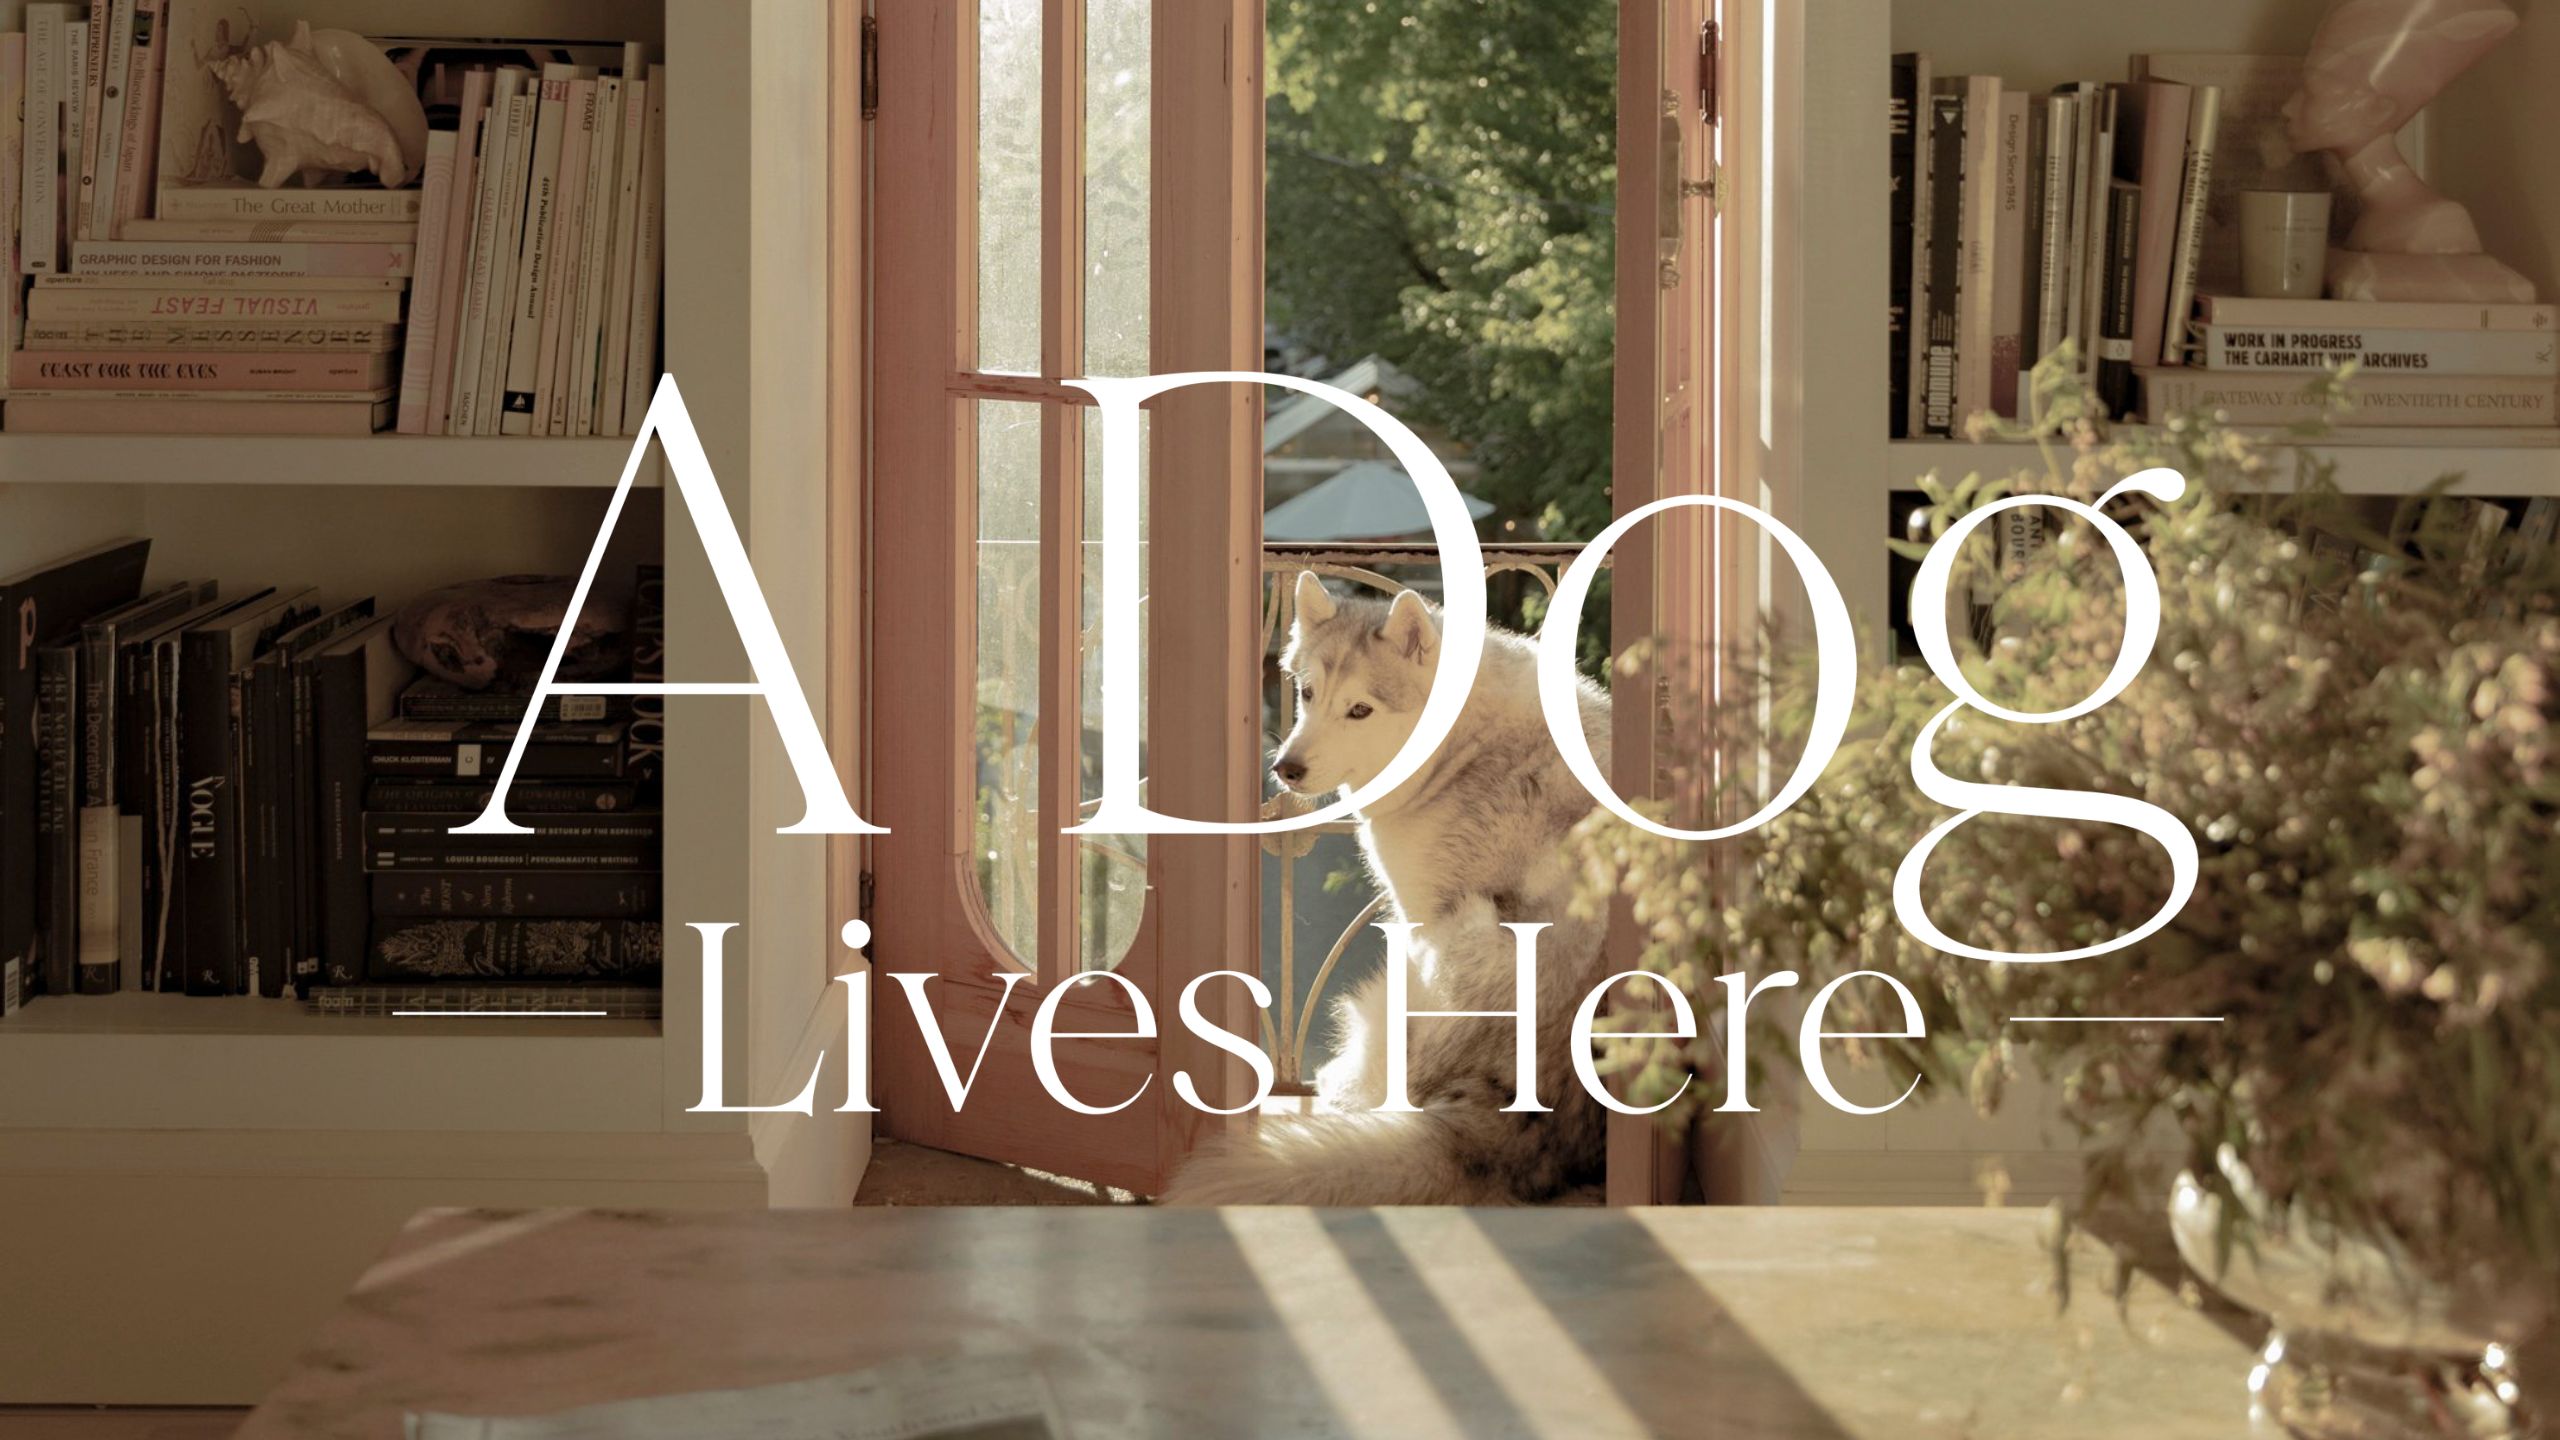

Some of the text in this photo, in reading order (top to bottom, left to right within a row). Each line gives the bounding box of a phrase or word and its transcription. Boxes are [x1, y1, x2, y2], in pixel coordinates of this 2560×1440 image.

[36, 20, 48, 46] THE
[71, 29, 79, 46] THE
[88, 4, 102, 88] ENTREPRENEURS
[36, 49, 48, 75] AGE
[71, 50, 79, 76] PARIS
[36, 79, 47, 96] OF
[71, 79, 79, 114] REVIEW
[125, 68, 146, 131] Bluestockings
[35, 101, 47, 204] CONVERSATION
[122, 145, 137, 173] Japan
[2004, 113, 2019, 211] Design Since 1945
[232, 197, 263, 214] The
[271, 197, 316, 214] Great
[323, 197, 386, 214] Mother
[534, 199, 549, 251] Publication
[79, 254, 282, 267] GRAPHIC DESIGN FOR FASHION
[529, 252, 541, 284] Design
[45, 275, 83, 285] aperture
[151, 296, 225, 314] FEAST
[234, 296, 319, 315] VISUAL
[526, 284, 539, 319] Annual
[2224, 332, 2363, 350] WORK IN PROGRESS
[40, 363, 218, 380] FEAST FOR THE EYES
[2224, 350, 2249, 366] THE
[2255, 351, 2324, 367] CARHARTT
[2362, 352, 2429, 369] ARCHIVES
[1928, 345, 1953, 427] commune
[459, 391, 471, 426] TASCHEN
[2362, 393, 2460, 408] TWENTIETH
[2464, 393, 2544, 409] CENTURY
[86, 680, 104, 708] The
[53, 711, 67, 794] NOUVEAU
[86, 712, 104, 789] Decorative
[372, 755, 452, 764] CHUCK KLOSTERMAN
[190, 775, 216, 859] VOGUE
[86, 848, 103, 896] France
[445, 855, 475, 864] LOUISE
[475, 855, 524, 864] BOURGEOIS
[600, 856, 640, 865] WRITINGS
